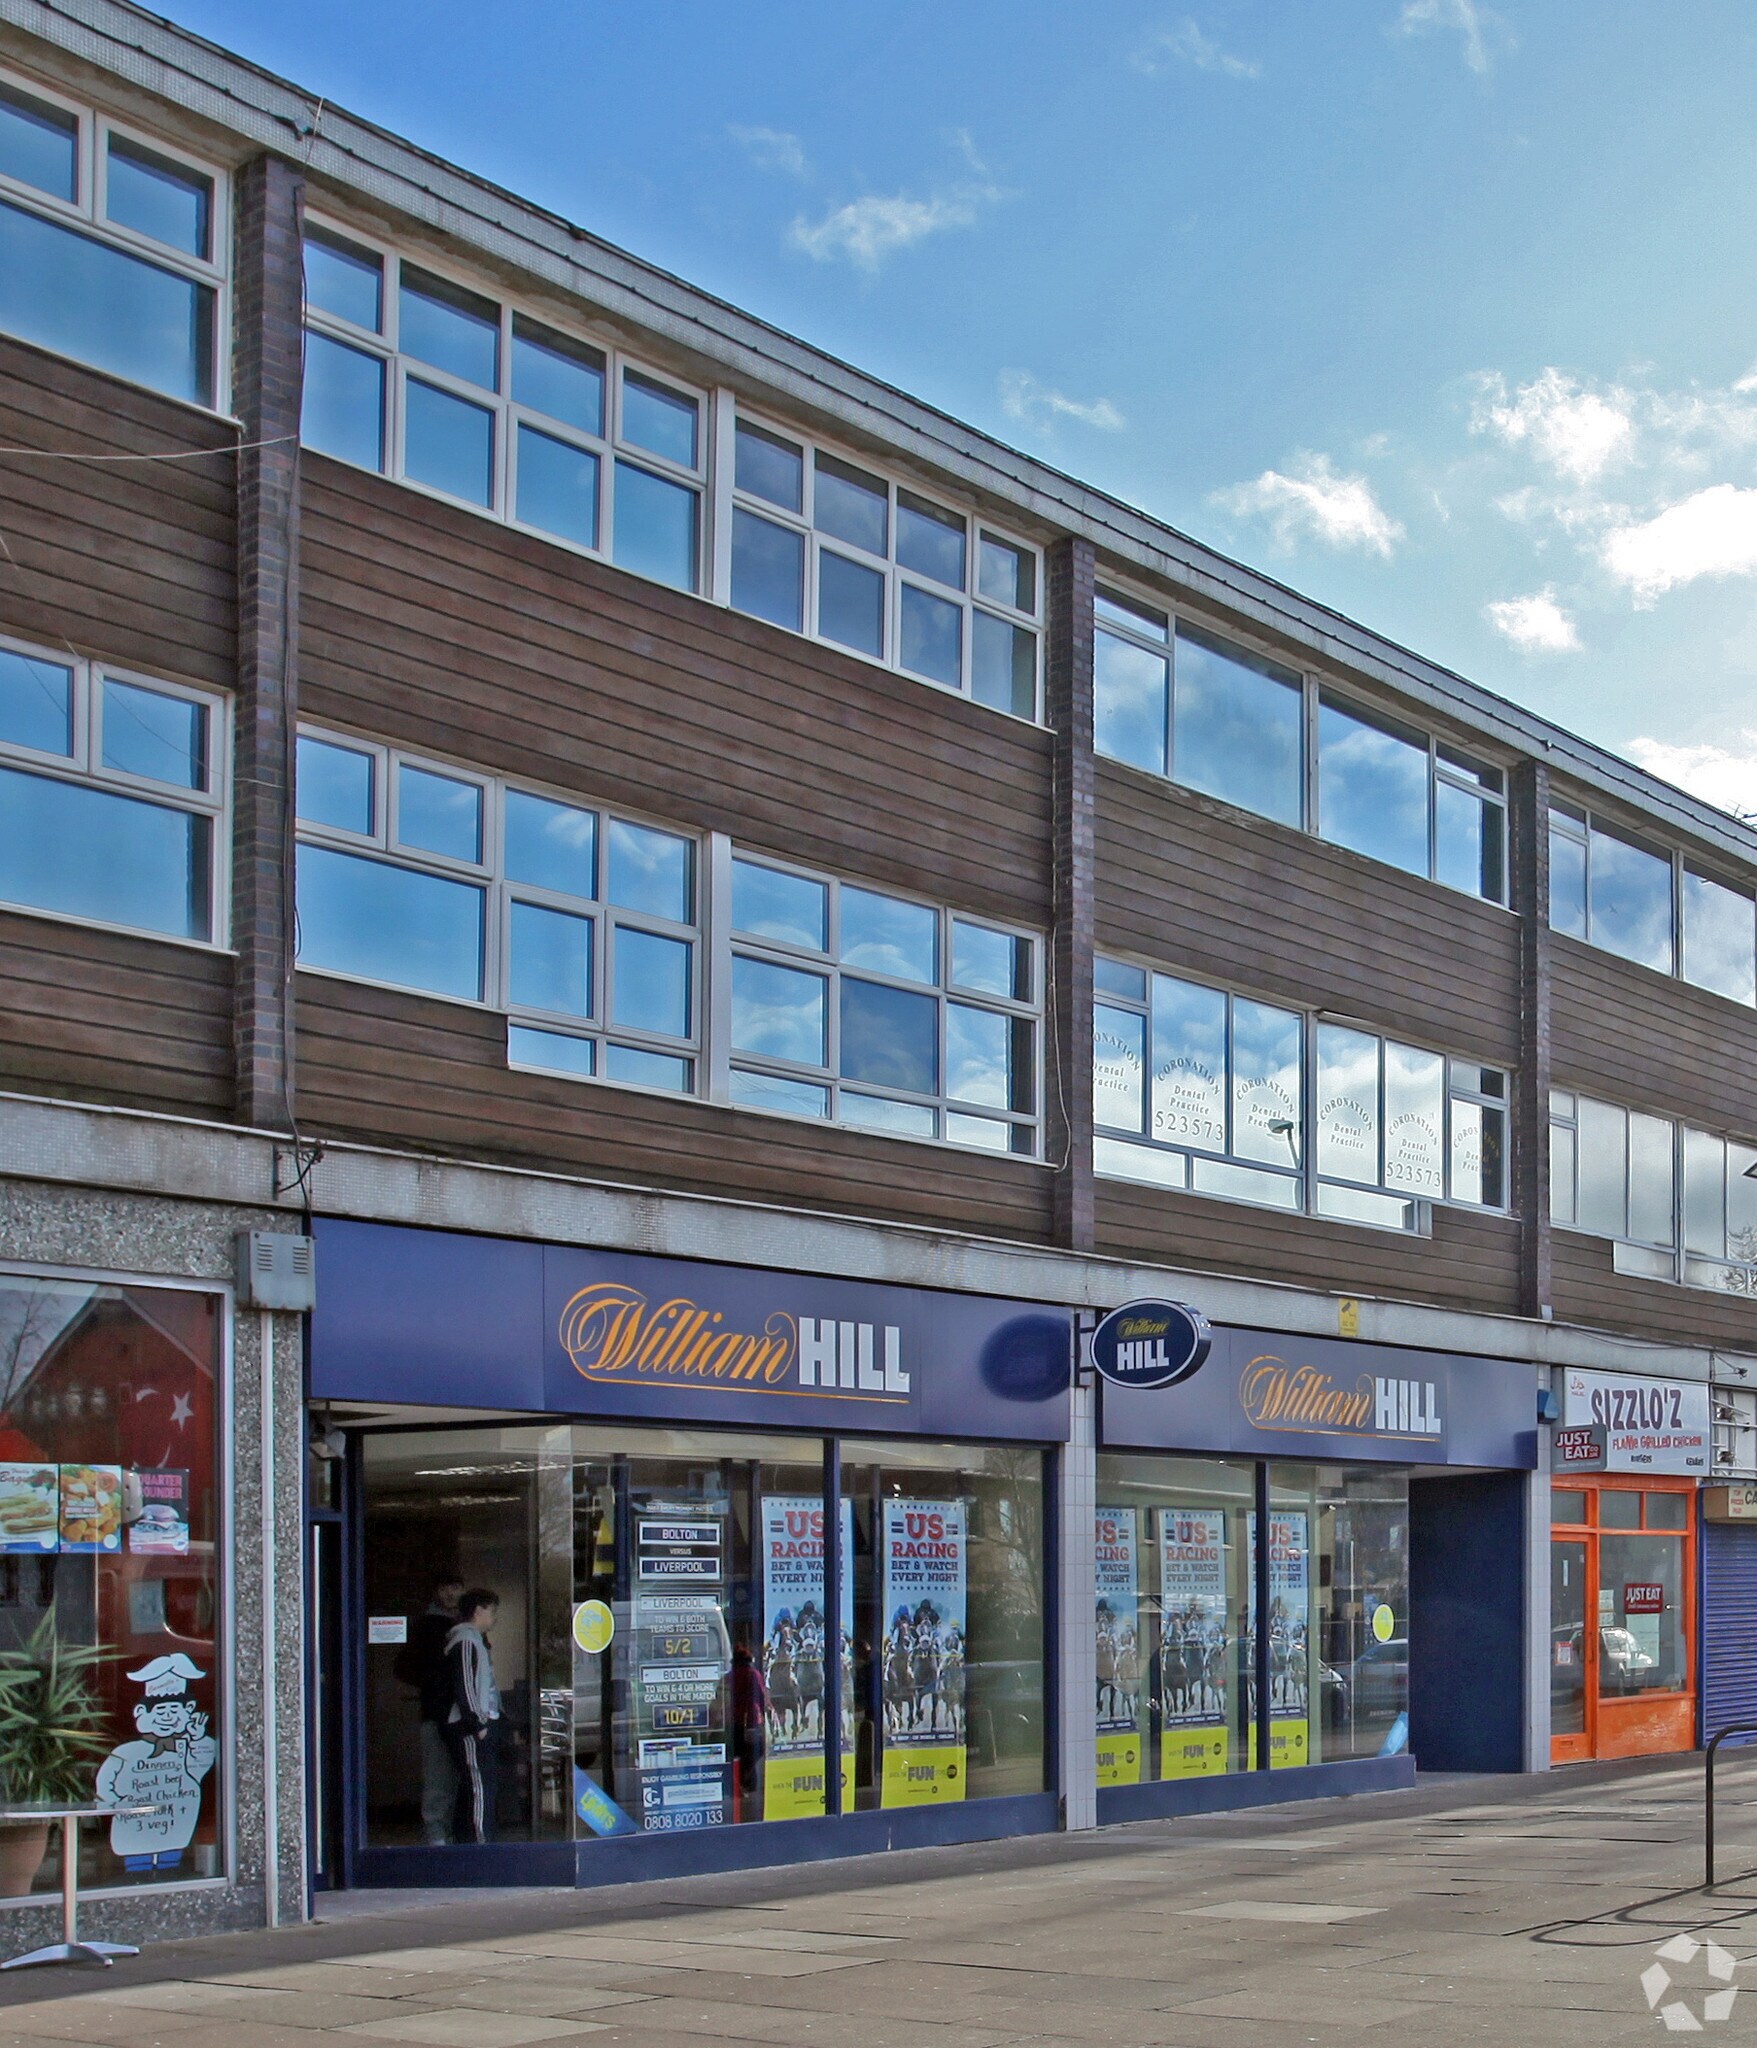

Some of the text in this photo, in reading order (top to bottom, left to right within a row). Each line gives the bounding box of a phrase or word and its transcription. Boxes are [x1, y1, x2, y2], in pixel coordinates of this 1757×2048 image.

[1157, 1057, 1221, 1096] CORONATION
[1174, 1084, 1207, 1101] Dental
[1236, 1077, 1295, 1114] CORONATION
[1169, 1097, 1210, 1115] Practice
[1251, 1104, 1281, 1118] Dental
[1319, 1097, 1374, 1131] CORONATION
[1155, 1110, 1224, 1141] 523573
[1334, 1122, 1362, 1137] Dental
[1388, 1113, 1438, 1147] CORONATION
[1330, 1134, 1365, 1149] Practice
[1401, 1138, 1427, 1151] Dental
[1398, 1149, 1431, 1164] Practice
[1386, 1161, 1441, 1187] 523573
[1117, 1316, 1171, 1337] William
[559, 1282, 911, 1394] William HILL
[1117, 1339, 1170, 1371] HILL
[1239, 1354, 1442, 1434] William HILL
[1557, 1431, 1591, 1446] JUST
[1565, 1445, 1590, 1460] EAT
[142, 1486, 182, 1499] OUNDER
[662, 1528, 698, 1540] BOLTON
[905, 1513, 944, 1541] US
[1175, 1521, 1208, 1545] US
[669, 1547, 692, 1555] VERSUS
[891, 1541, 959, 1559] RACING
[1166, 1547, 1218, 1560] RACING
[654, 1562, 705, 1573] LIVERPOOL
[771, 1561, 793, 1571] BET
[891, 1560, 959, 1571] BET & WATCH
[1100, 1563, 1130, 1572] WATCH
[1166, 1563, 1180, 1572] BET
[1191, 1563, 1219, 1572] WATCH
[771, 1573, 806, 1584] EVERY
[891, 1572, 959, 1582] EVERY NIGHT
[1103, 1574, 1130, 1583] NIGHT
[1166, 1573, 1219, 1582] EVERY NIGHT
[1626, 1587, 1661, 1601] JUST EAT
[653, 1598, 704, 1608] LIVERPOOL
[650, 1624, 710, 1633] TEAMS TO SCORE
[665, 1638, 691, 1655] 5/2
[663, 1669, 699, 1680] BOLTON
[646, 1685, 655, 1693] TO
[644, 1693, 669, 1703] GOALS
[678, 1693, 692, 1701] THE
[692, 1692, 717, 1700] MATCH
[664, 1708, 695, 1725] 10/1
[1183, 1744, 1204, 1759] FUN
[908, 1765, 935, 1781] FUN
[132, 1774, 182, 1792] Roast beef
[793, 1774, 823, 1792] FUN
[136, 1820, 143, 1832] 3
[644, 1815, 673, 1830] 0808
[674, 1811, 703, 1827] 8020
[706, 1810, 723, 1824] 133
